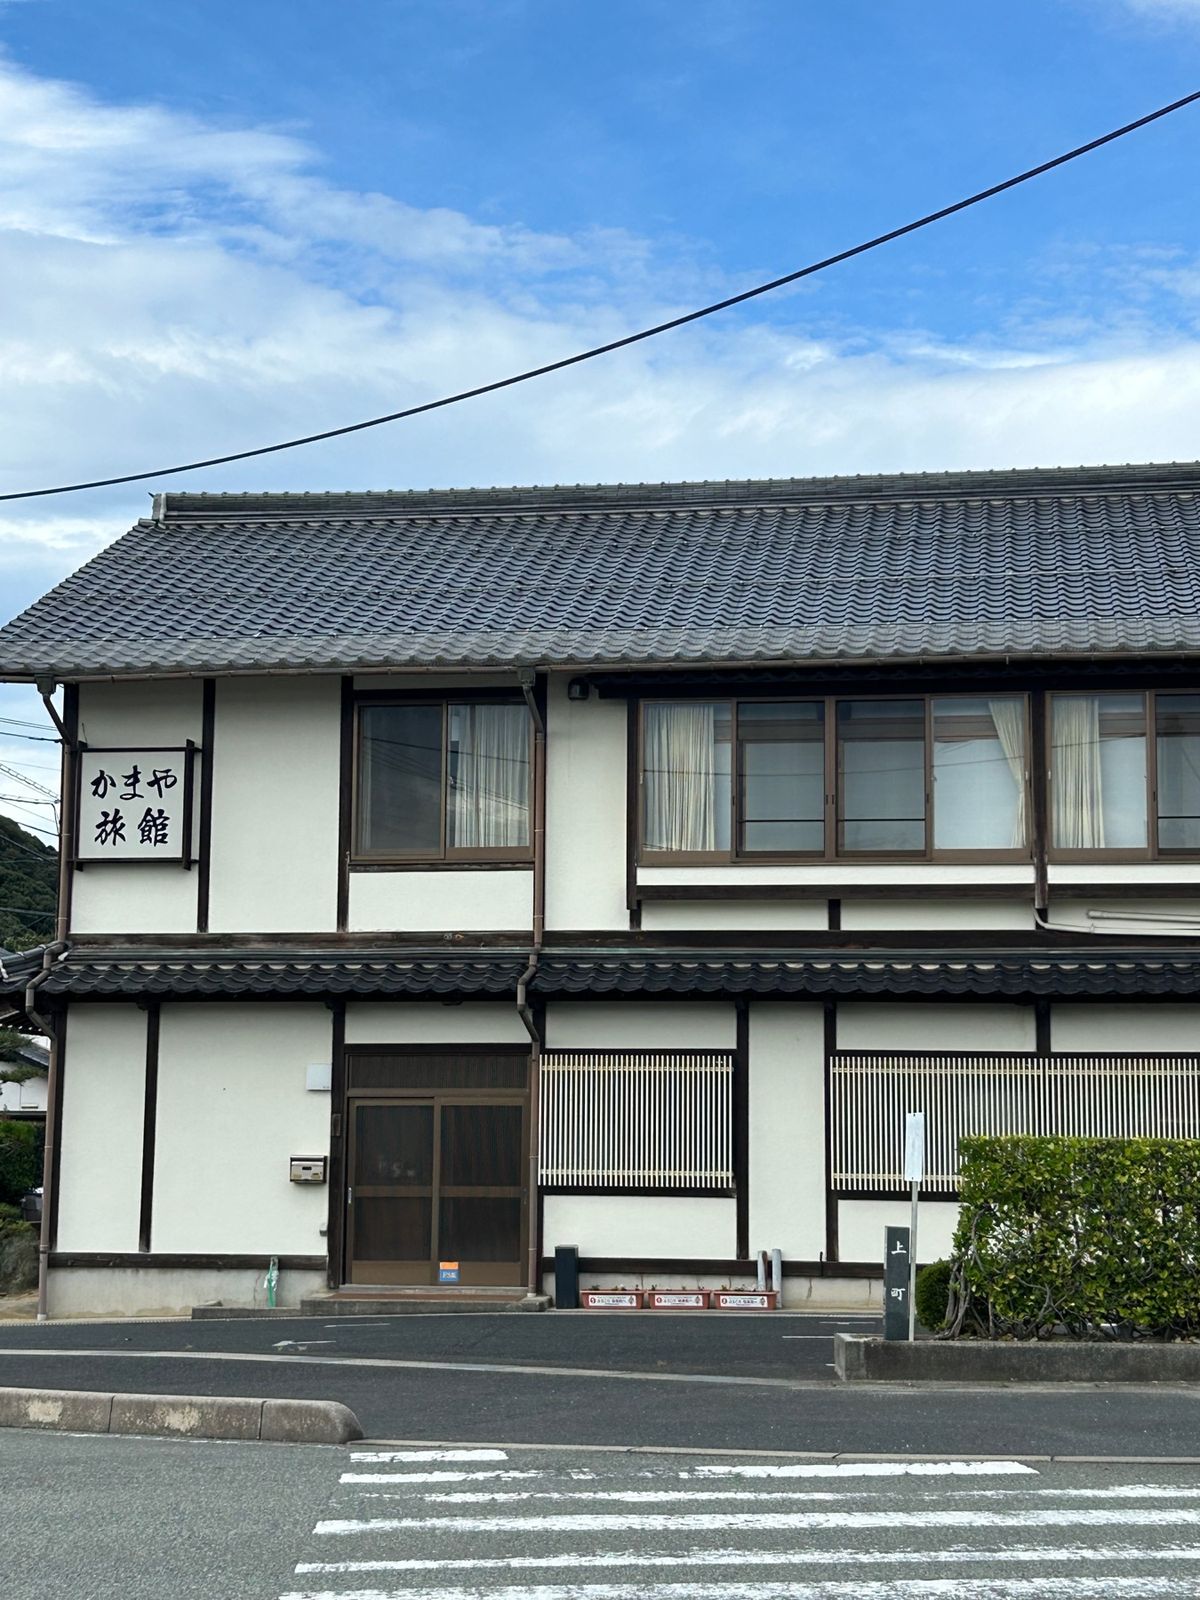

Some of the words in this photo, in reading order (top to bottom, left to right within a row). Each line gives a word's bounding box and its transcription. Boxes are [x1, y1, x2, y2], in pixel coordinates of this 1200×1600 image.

[90, 765, 178, 800] かまや
[94, 807, 170, 847] 旅館
[890, 1240, 907, 1301] 上町
